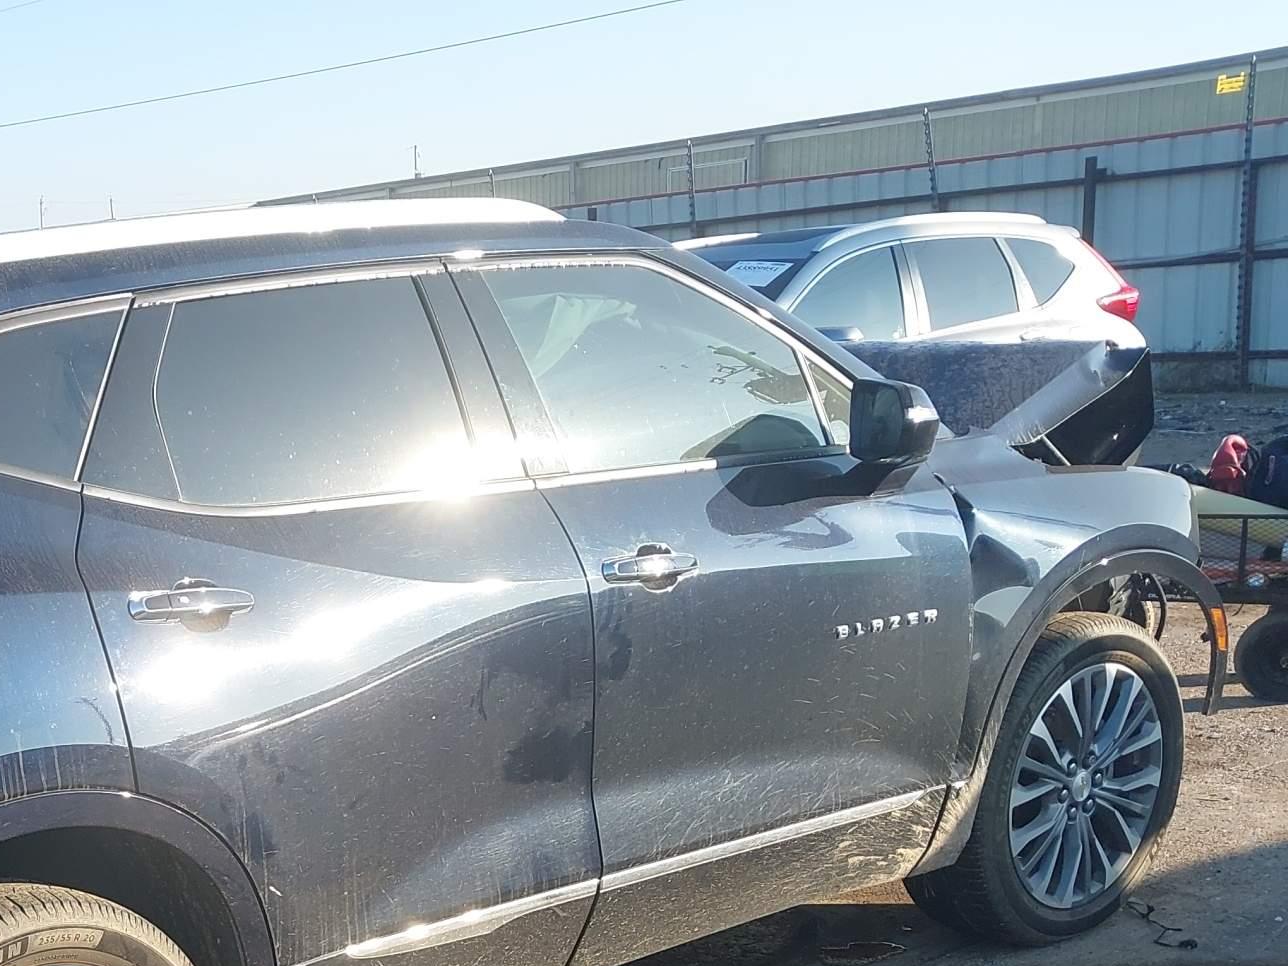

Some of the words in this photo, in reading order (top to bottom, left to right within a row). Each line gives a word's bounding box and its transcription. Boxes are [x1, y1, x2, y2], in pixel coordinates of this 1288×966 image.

[834, 609, 938, 639] BLAZER
[38, 932, 72, 946] 235/55
[83, 934, 95, 943] 20
